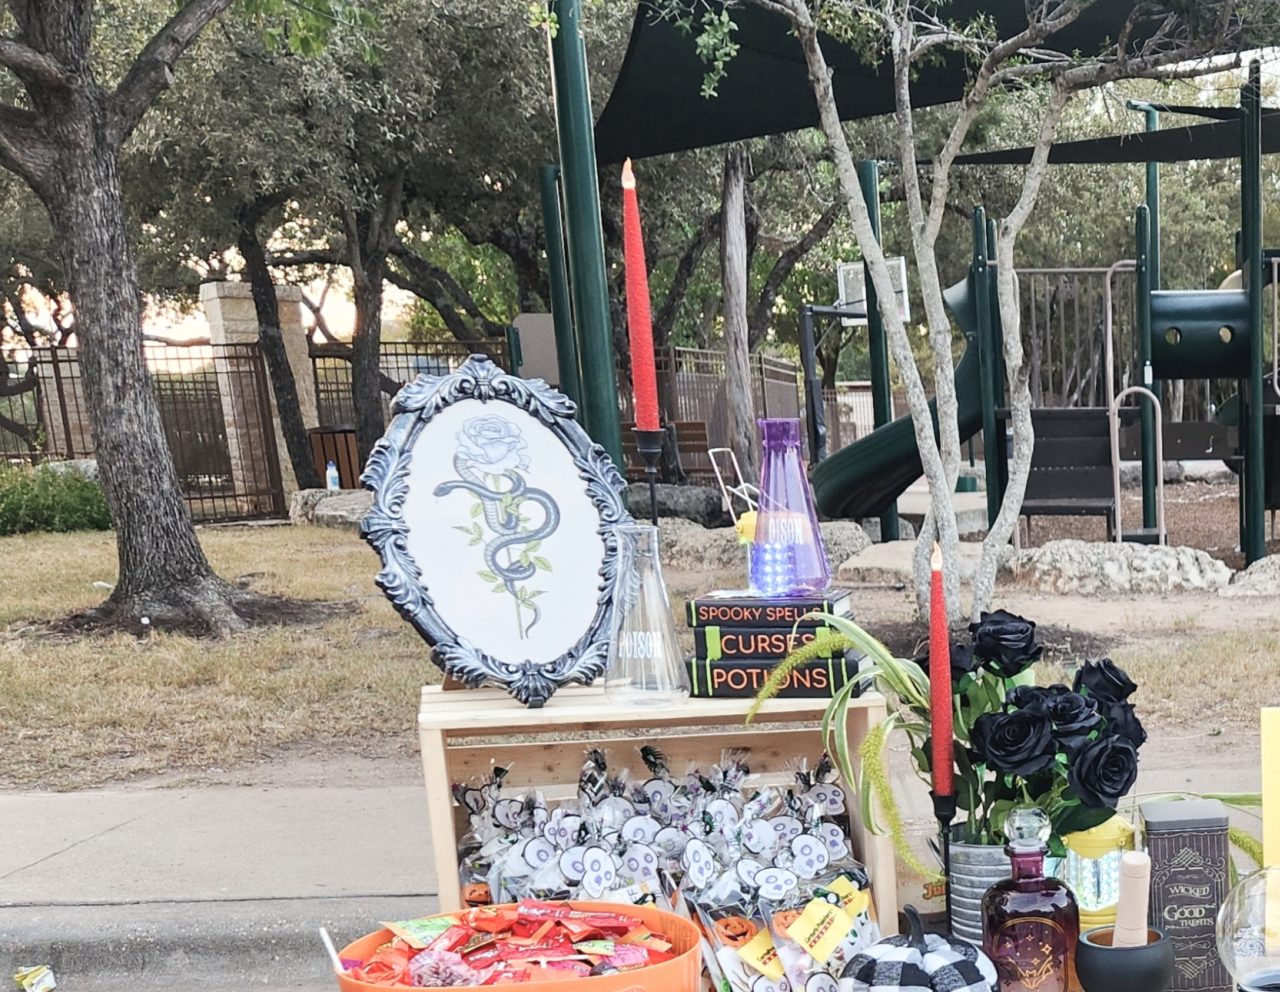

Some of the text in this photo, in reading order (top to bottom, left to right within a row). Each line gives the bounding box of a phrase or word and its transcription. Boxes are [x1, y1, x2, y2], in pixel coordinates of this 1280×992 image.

[698, 606, 822, 621] SPOOKY SPELLS
[721, 633, 816, 654] CURSES
[713, 667, 828, 690] POTIONS
[1169, 885, 1211, 897] WICKED
